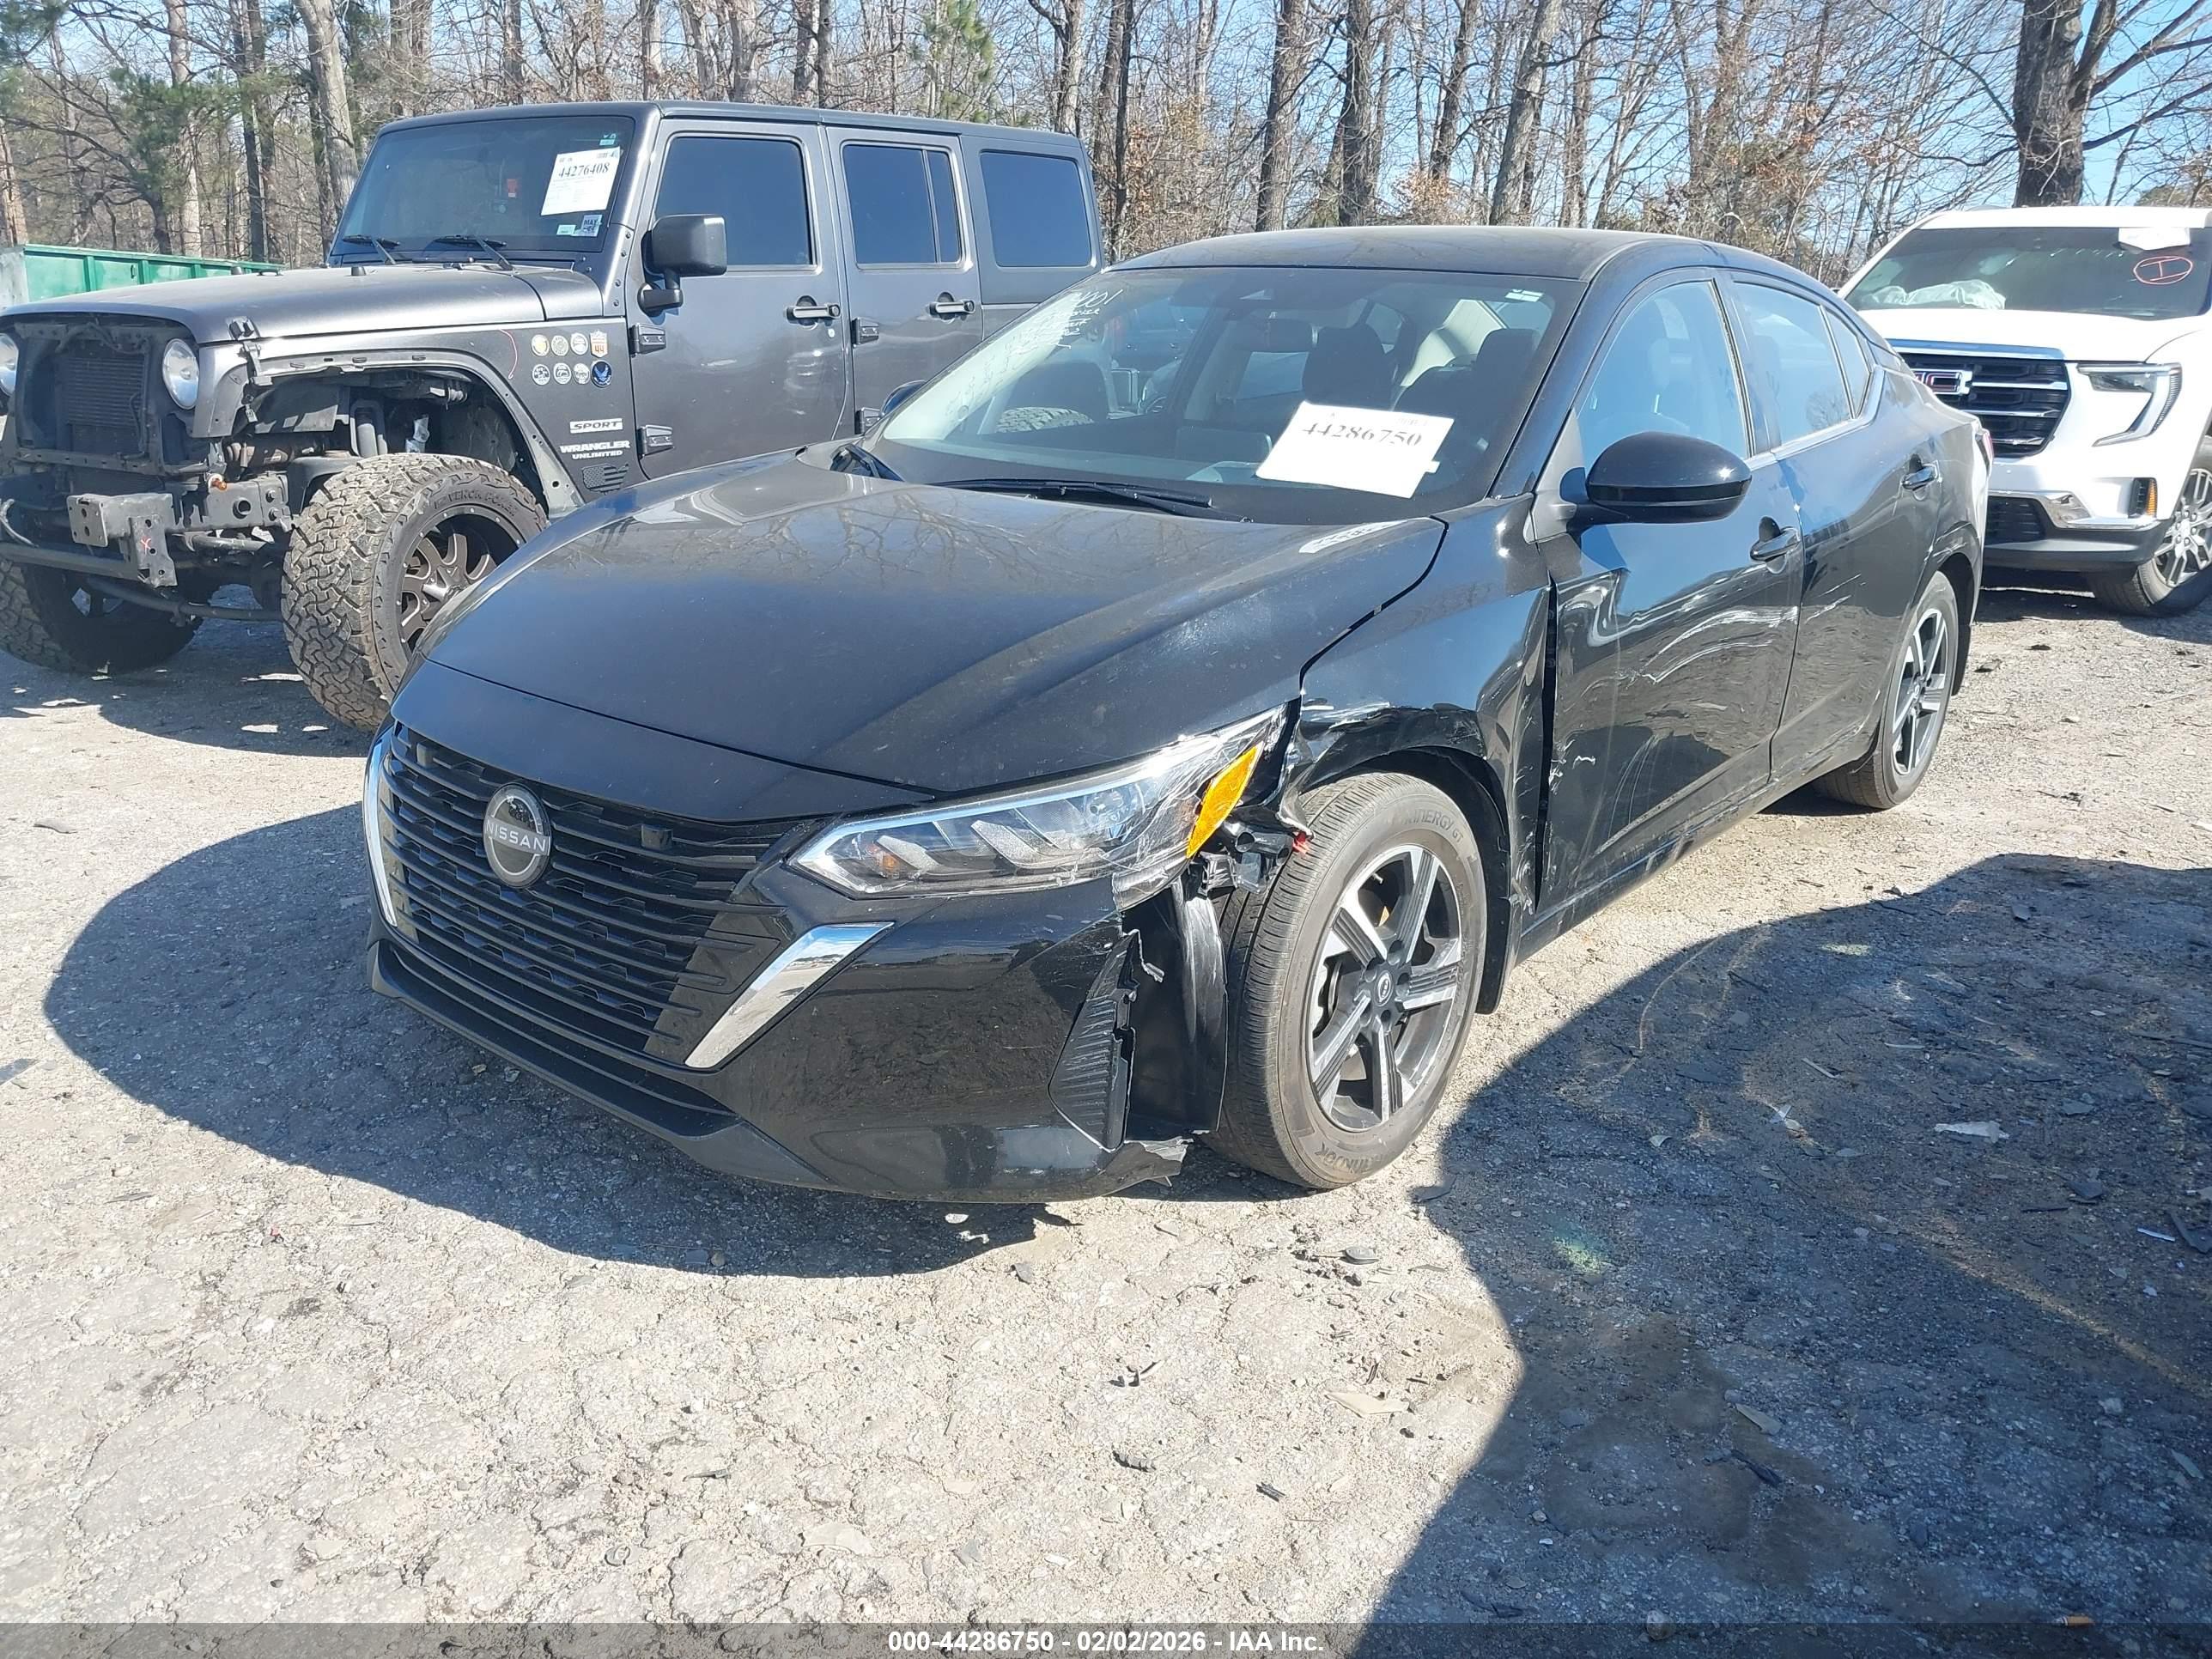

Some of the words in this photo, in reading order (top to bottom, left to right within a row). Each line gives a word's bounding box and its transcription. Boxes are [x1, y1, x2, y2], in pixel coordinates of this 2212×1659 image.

[558, 161, 610, 178] 44276408
[594, 344, 605, 354] 44
[574, 421, 618, 430] SPORT
[1301, 422, 1423, 447] 44286750
[560, 440, 631, 453] WRANGLER
[572, 450, 623, 460] UNLIMITED
[485, 819, 546, 853] NISSAN
[1452, 827, 1464, 842] GT
